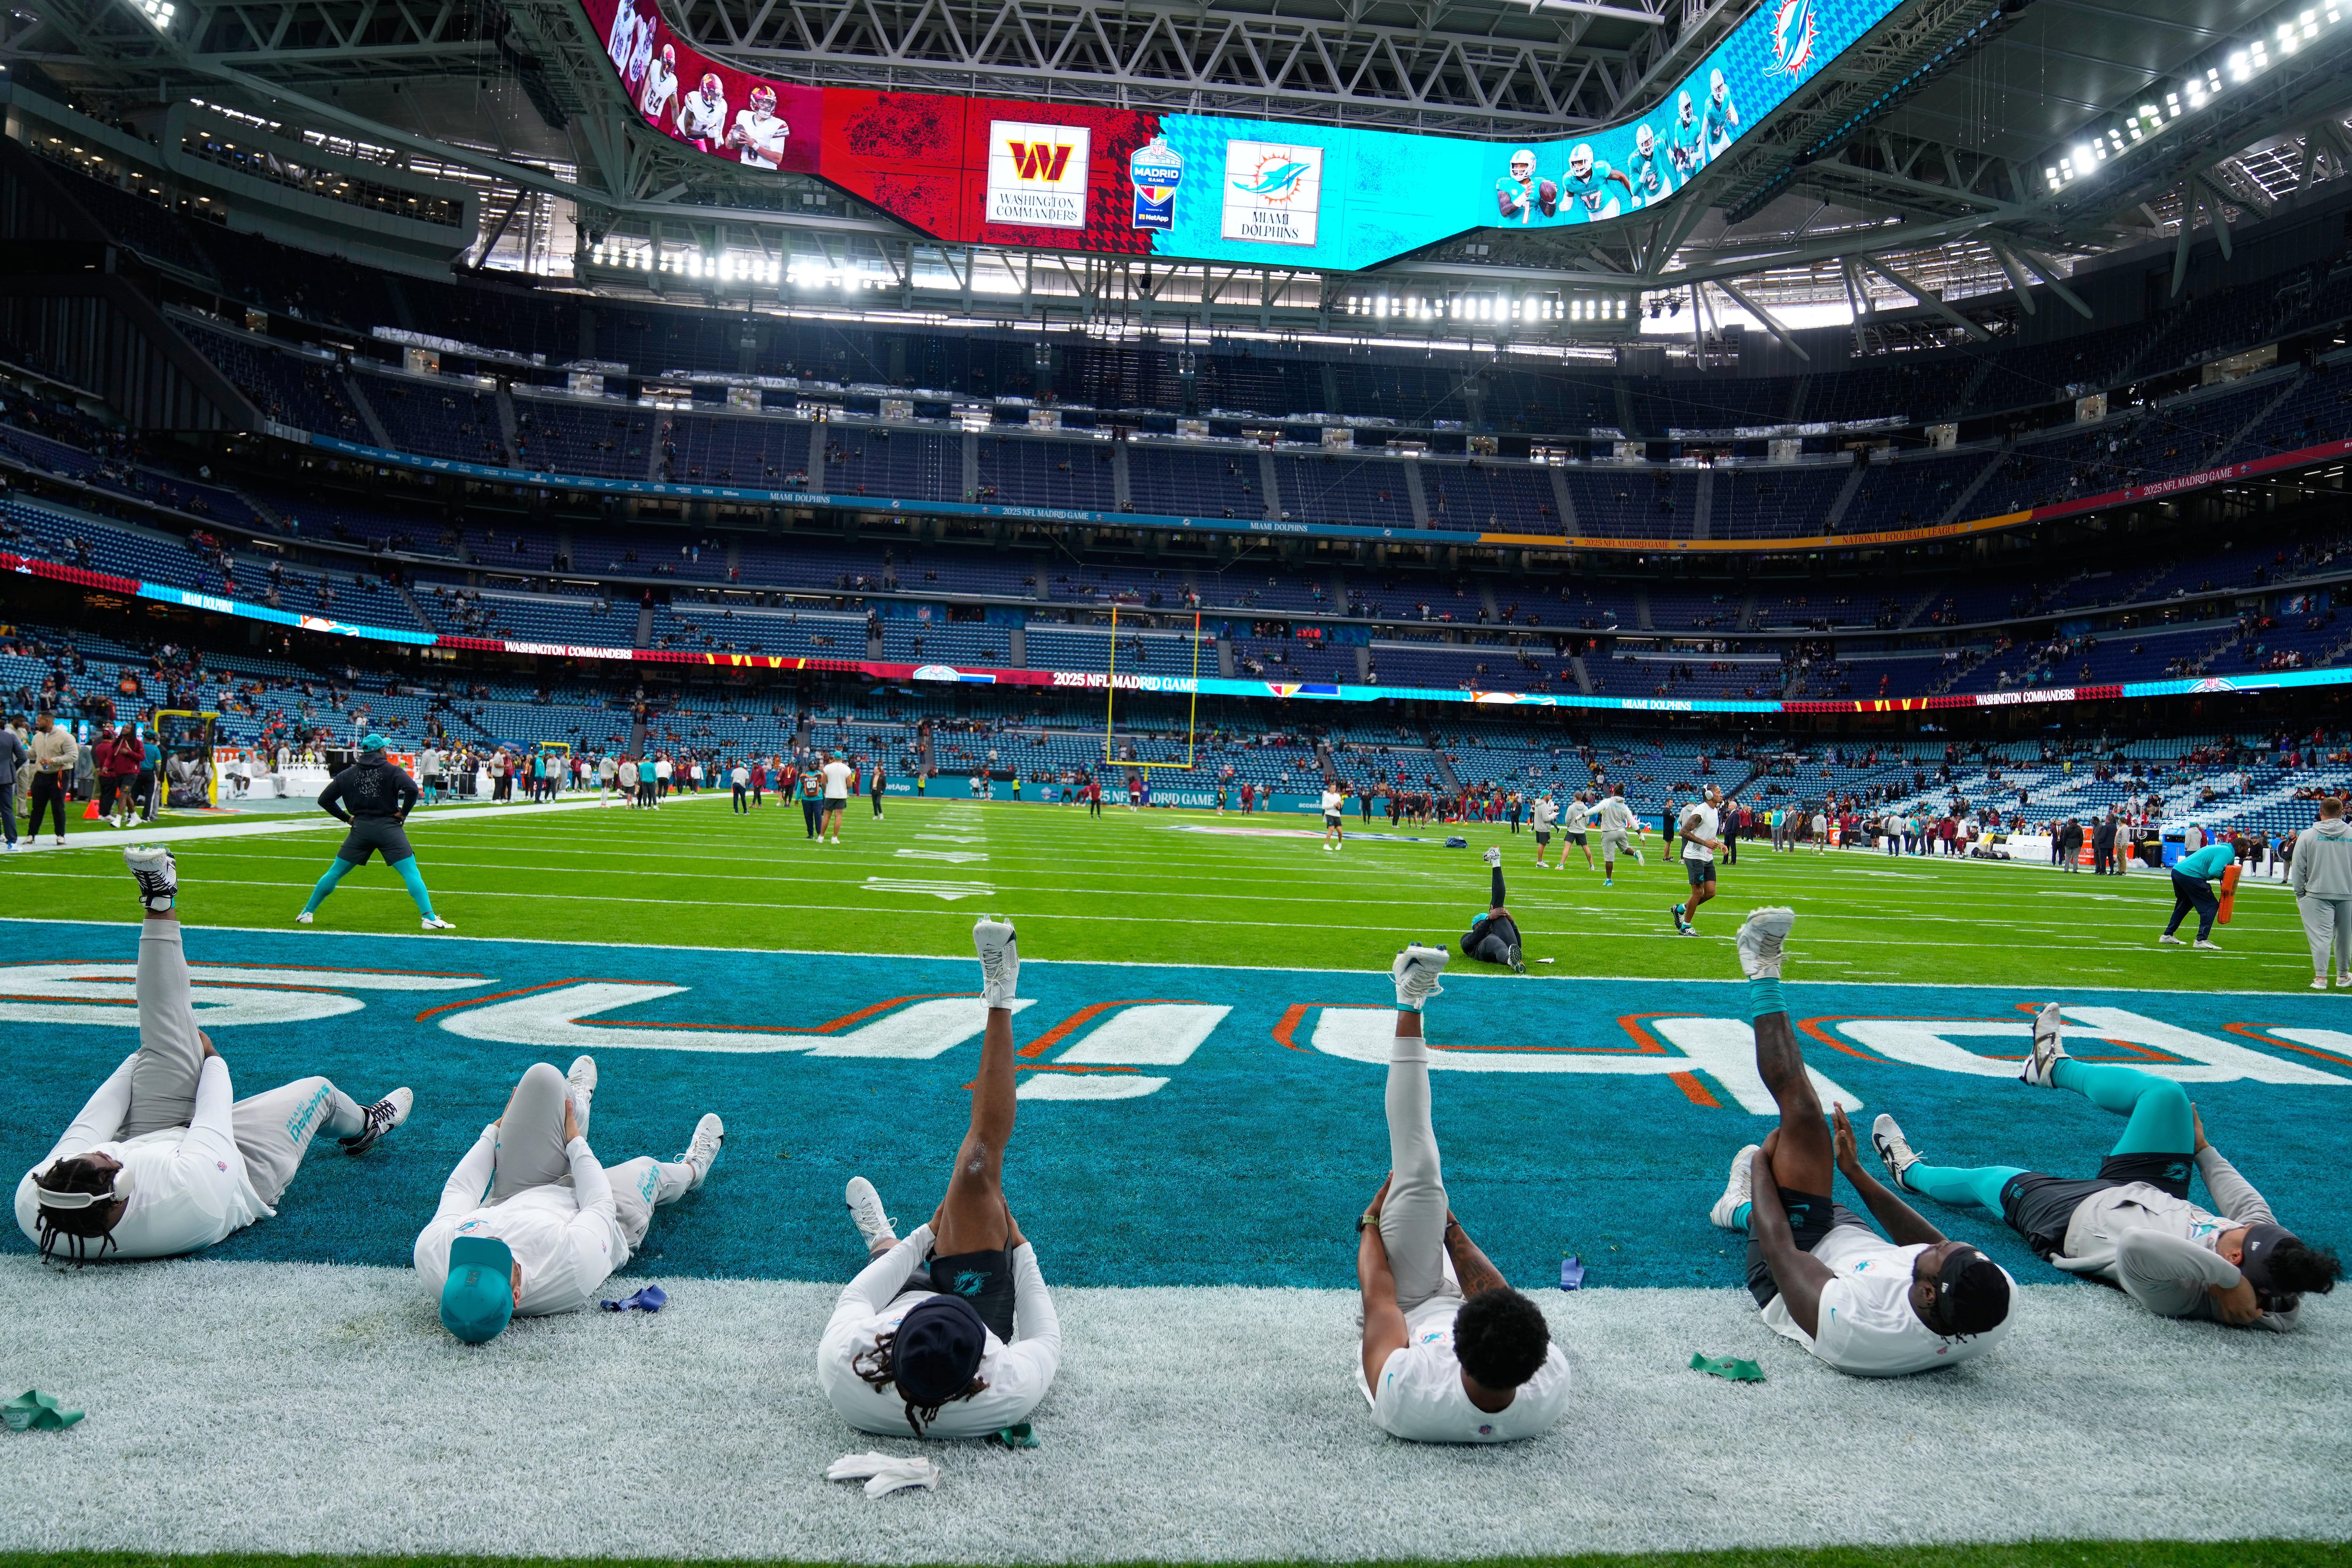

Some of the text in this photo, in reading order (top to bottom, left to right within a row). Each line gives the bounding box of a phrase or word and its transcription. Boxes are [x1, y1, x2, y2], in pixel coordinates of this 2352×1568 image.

[1152, 146, 1164, 154] NFL
[1134, 167, 1179, 179] MADRID
[1001, 193, 1074, 209] WASHINGTON
[1581, 190, 1602, 209] 17
[997, 205, 1078, 221] COMMANDERS
[1145, 214, 1169, 222] NetApp
[1253, 212, 1289, 225] MIAMI
[1242, 224, 1298, 239] DOLPHINS
[2144, 467, 2232, 495] 2025 NFL MADRID GAME
[770, 493, 830, 504] MIAMI DOLPHINS
[1002, 507, 1089, 520] 2025 NFL MADRID GAME
[1274, 523, 1308, 532] DOLPHINS
[1843, 525, 1958, 545] NATIONAL FOOTBALL LEAGUE
[182, 592, 234, 613] MIAMI DOLPHINS
[505, 641, 633, 659] WASHINGTON COMMANDERS
[1053, 672, 1199, 692] 2025 NFL MADRID GAME
[2206, 678, 2217, 688] NFL
[1976, 689, 2075, 705] WASHINGTON COMMANDERS
[1622, 699, 1692, 711] MIAMI DOLPHINS
[1181, 793, 1215, 806] GAME
[286, 1101, 305, 1130] MIAMI
[290, 1084, 330, 1143] Dolphins
